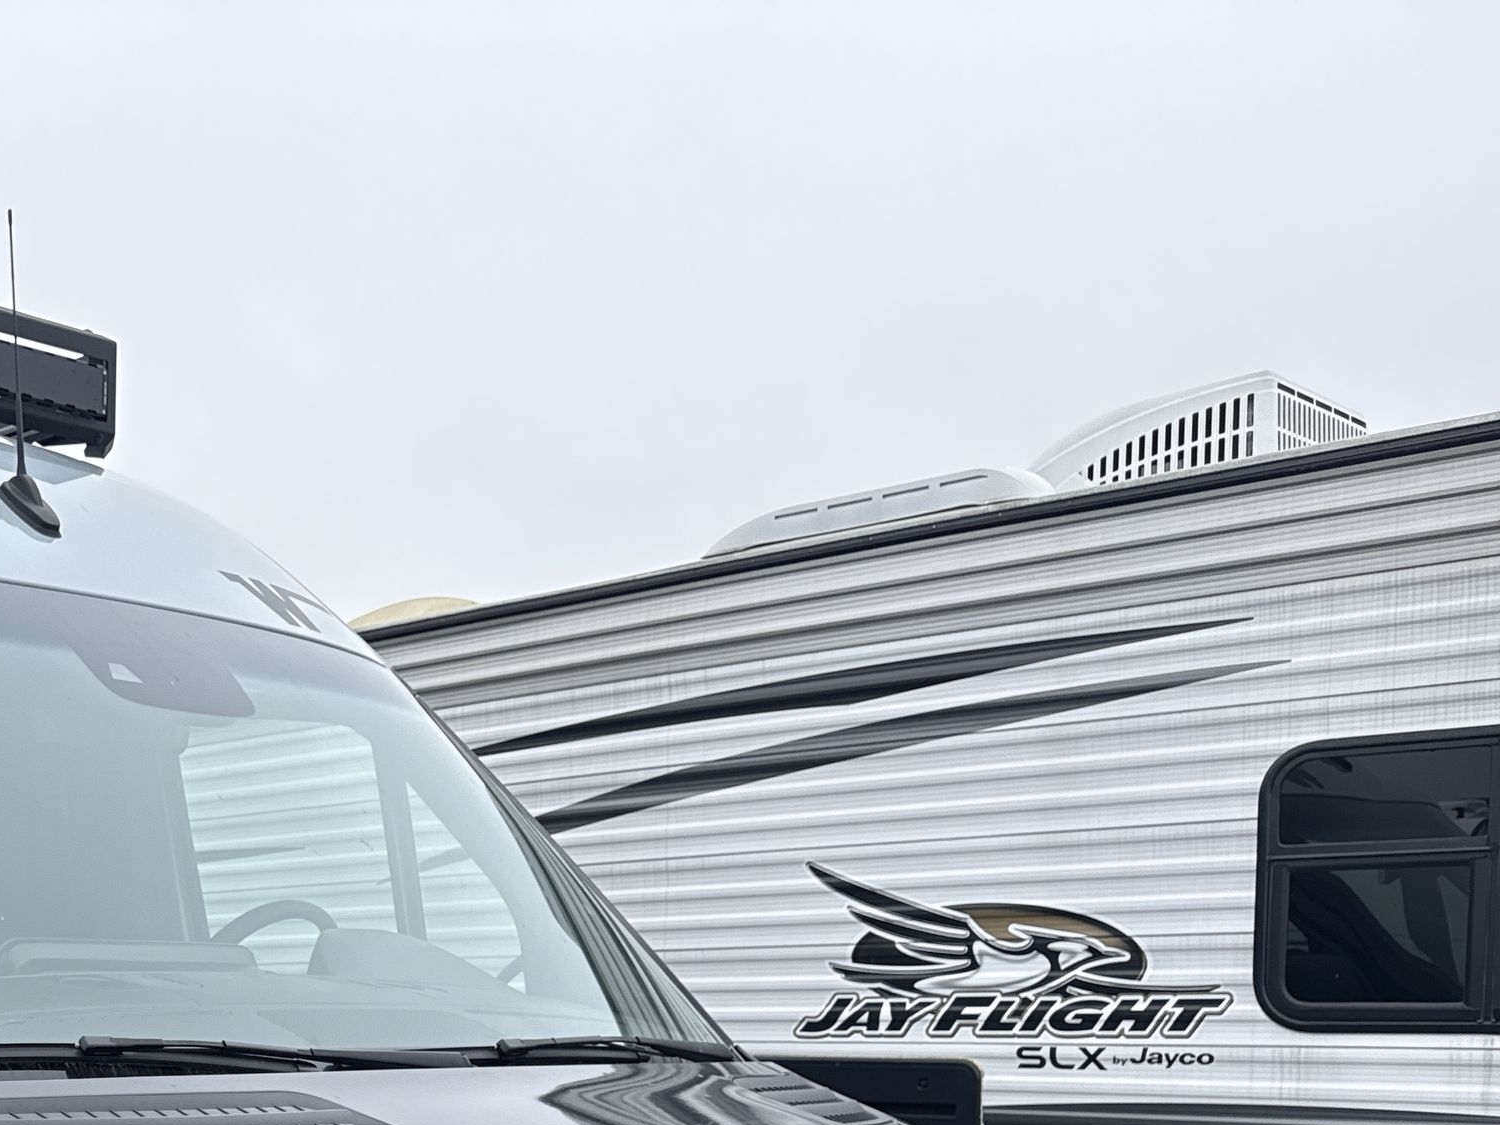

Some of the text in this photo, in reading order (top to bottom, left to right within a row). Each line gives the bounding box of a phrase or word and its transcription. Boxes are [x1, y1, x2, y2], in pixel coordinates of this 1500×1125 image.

[797, 994, 1231, 1035] JAY FLIGHT
[1015, 1045, 1216, 1071] SLX by Jayco
